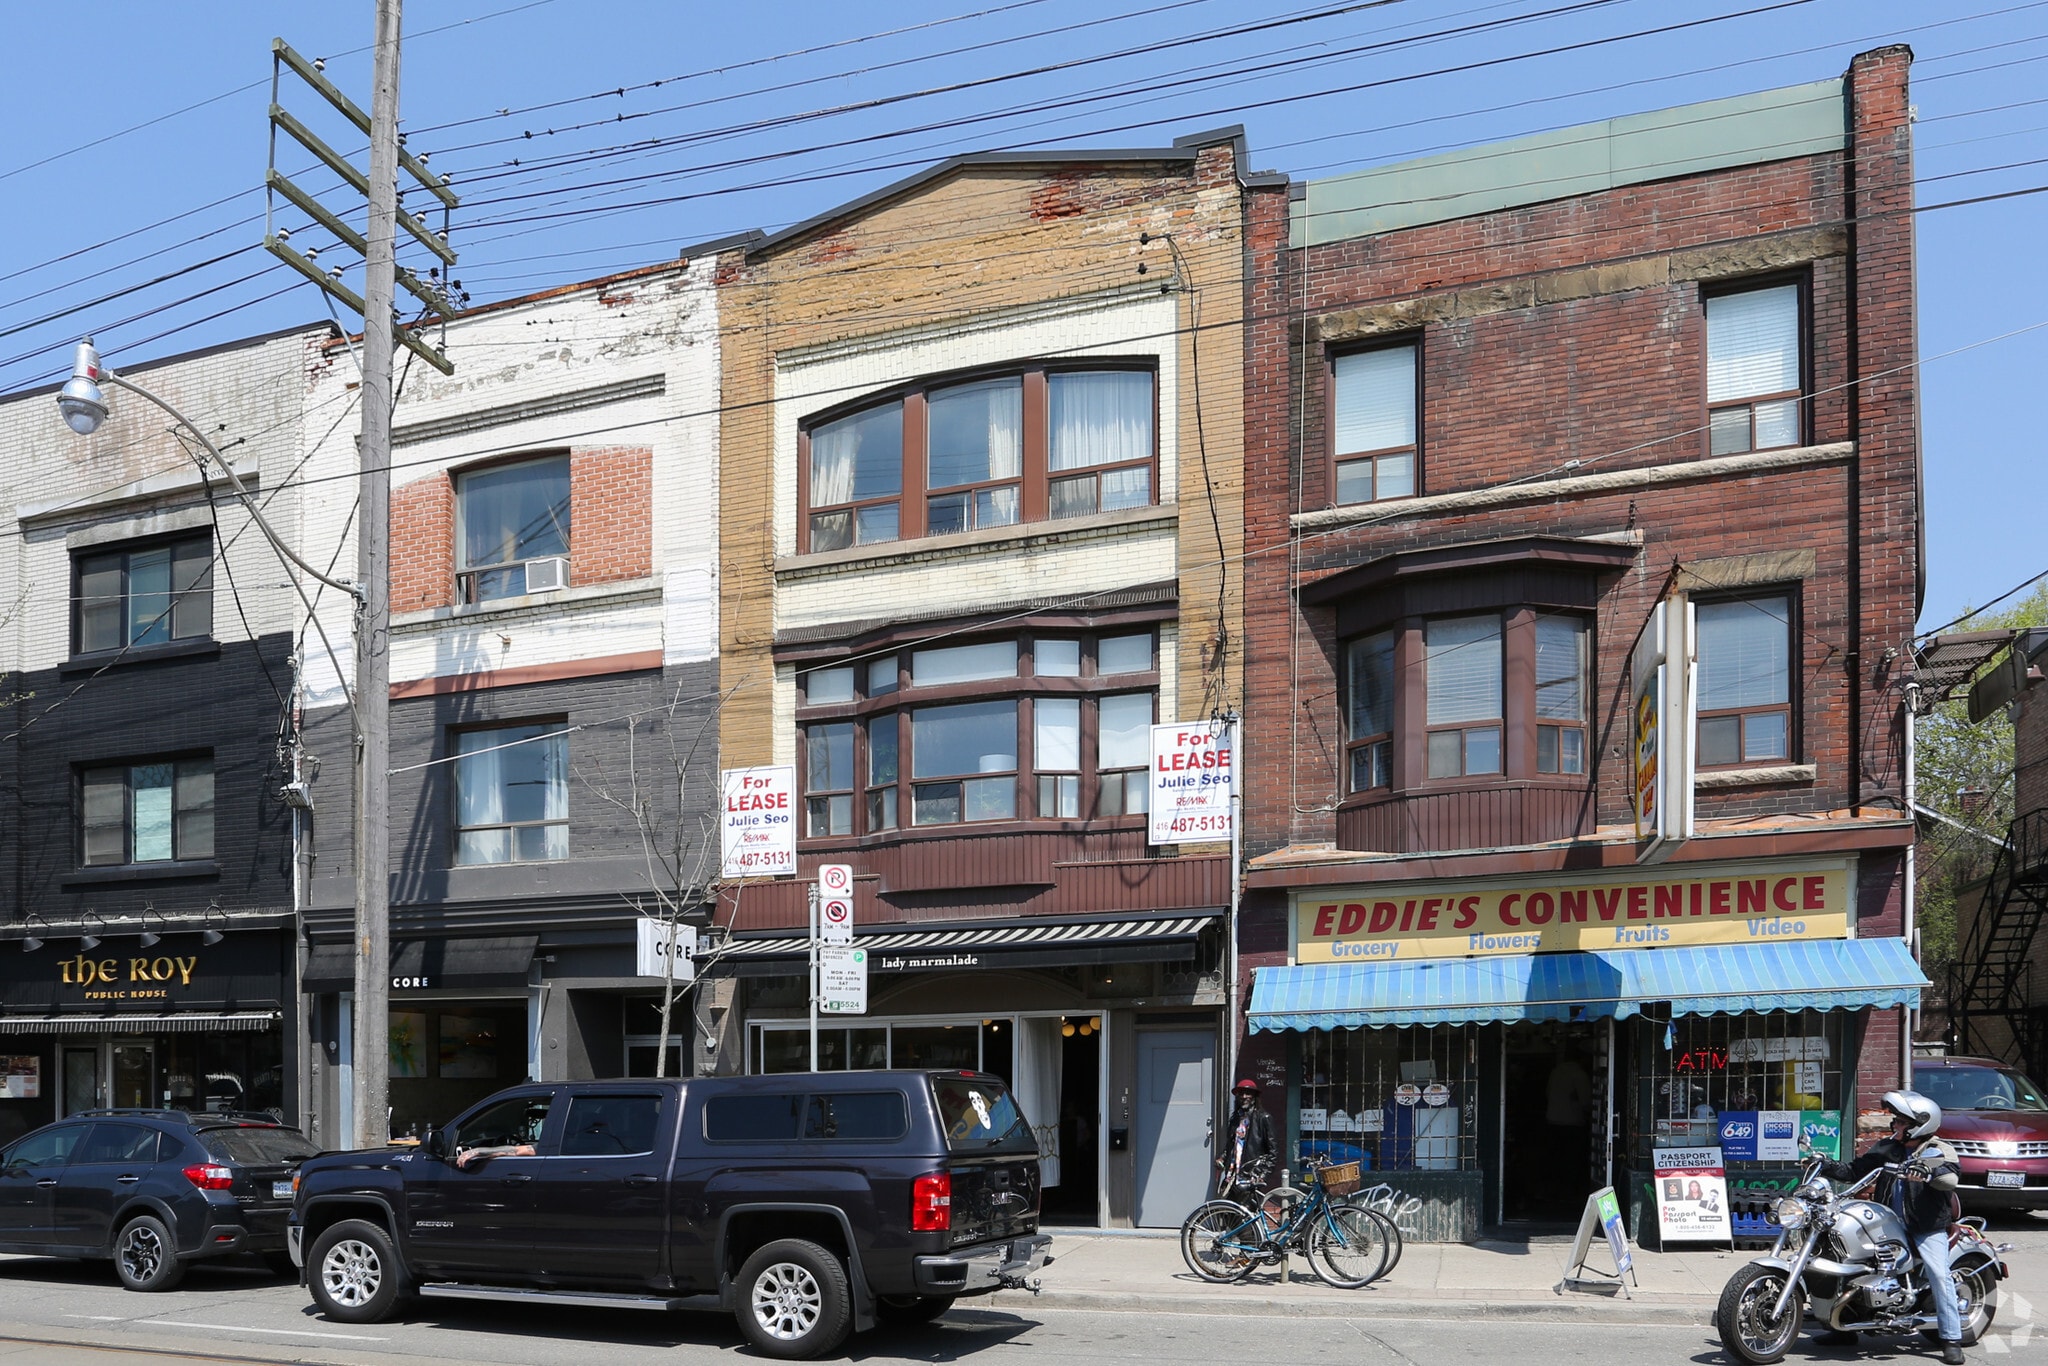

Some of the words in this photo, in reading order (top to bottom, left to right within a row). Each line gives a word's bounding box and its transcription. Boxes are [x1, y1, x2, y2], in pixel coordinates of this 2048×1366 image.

[1177, 732, 1211, 746] For
[1158, 749, 1231, 772] LEASE
[743, 776, 772, 790] For
[1158, 775, 1196, 788] Julie
[1201, 773, 1232, 785] Seo
[728, 792, 788, 812] LEASE
[1176, 795, 1209, 806] RE/MAX
[728, 814, 760, 827] Julie
[764, 813, 789, 825] Seo
[1155, 821, 1169, 831] 416
[1170, 815, 1232, 832] 487-5131
[740, 851, 791, 867] 487-5131
[1313, 896, 1481, 937] EDDIE'S
[1498, 875, 1825, 926] CONVENIENCE
[1331, 940, 1399, 958] Grocery
[1469, 931, 1541, 950] Flowers
[1615, 923, 1670, 943] Fruits
[1746, 916, 1806, 937] Video
[882, 957, 906, 971] lady
[908, 954, 978, 967] marmalade
[128, 956, 197, 985] ROY
[392, 977, 428, 988] CORE
[85, 991, 126, 999] PUBLIC
[130, 990, 168, 998] HOUSE
[1676, 1051, 1729, 1071] ATM
[1723, 1123, 1752, 1137] 649
[1803, 1123, 1838, 1137] MAX
[1661, 1152, 1711, 1160] PASSPORT
[1658, 1160, 1716, 1168] CITIZENSHIP
